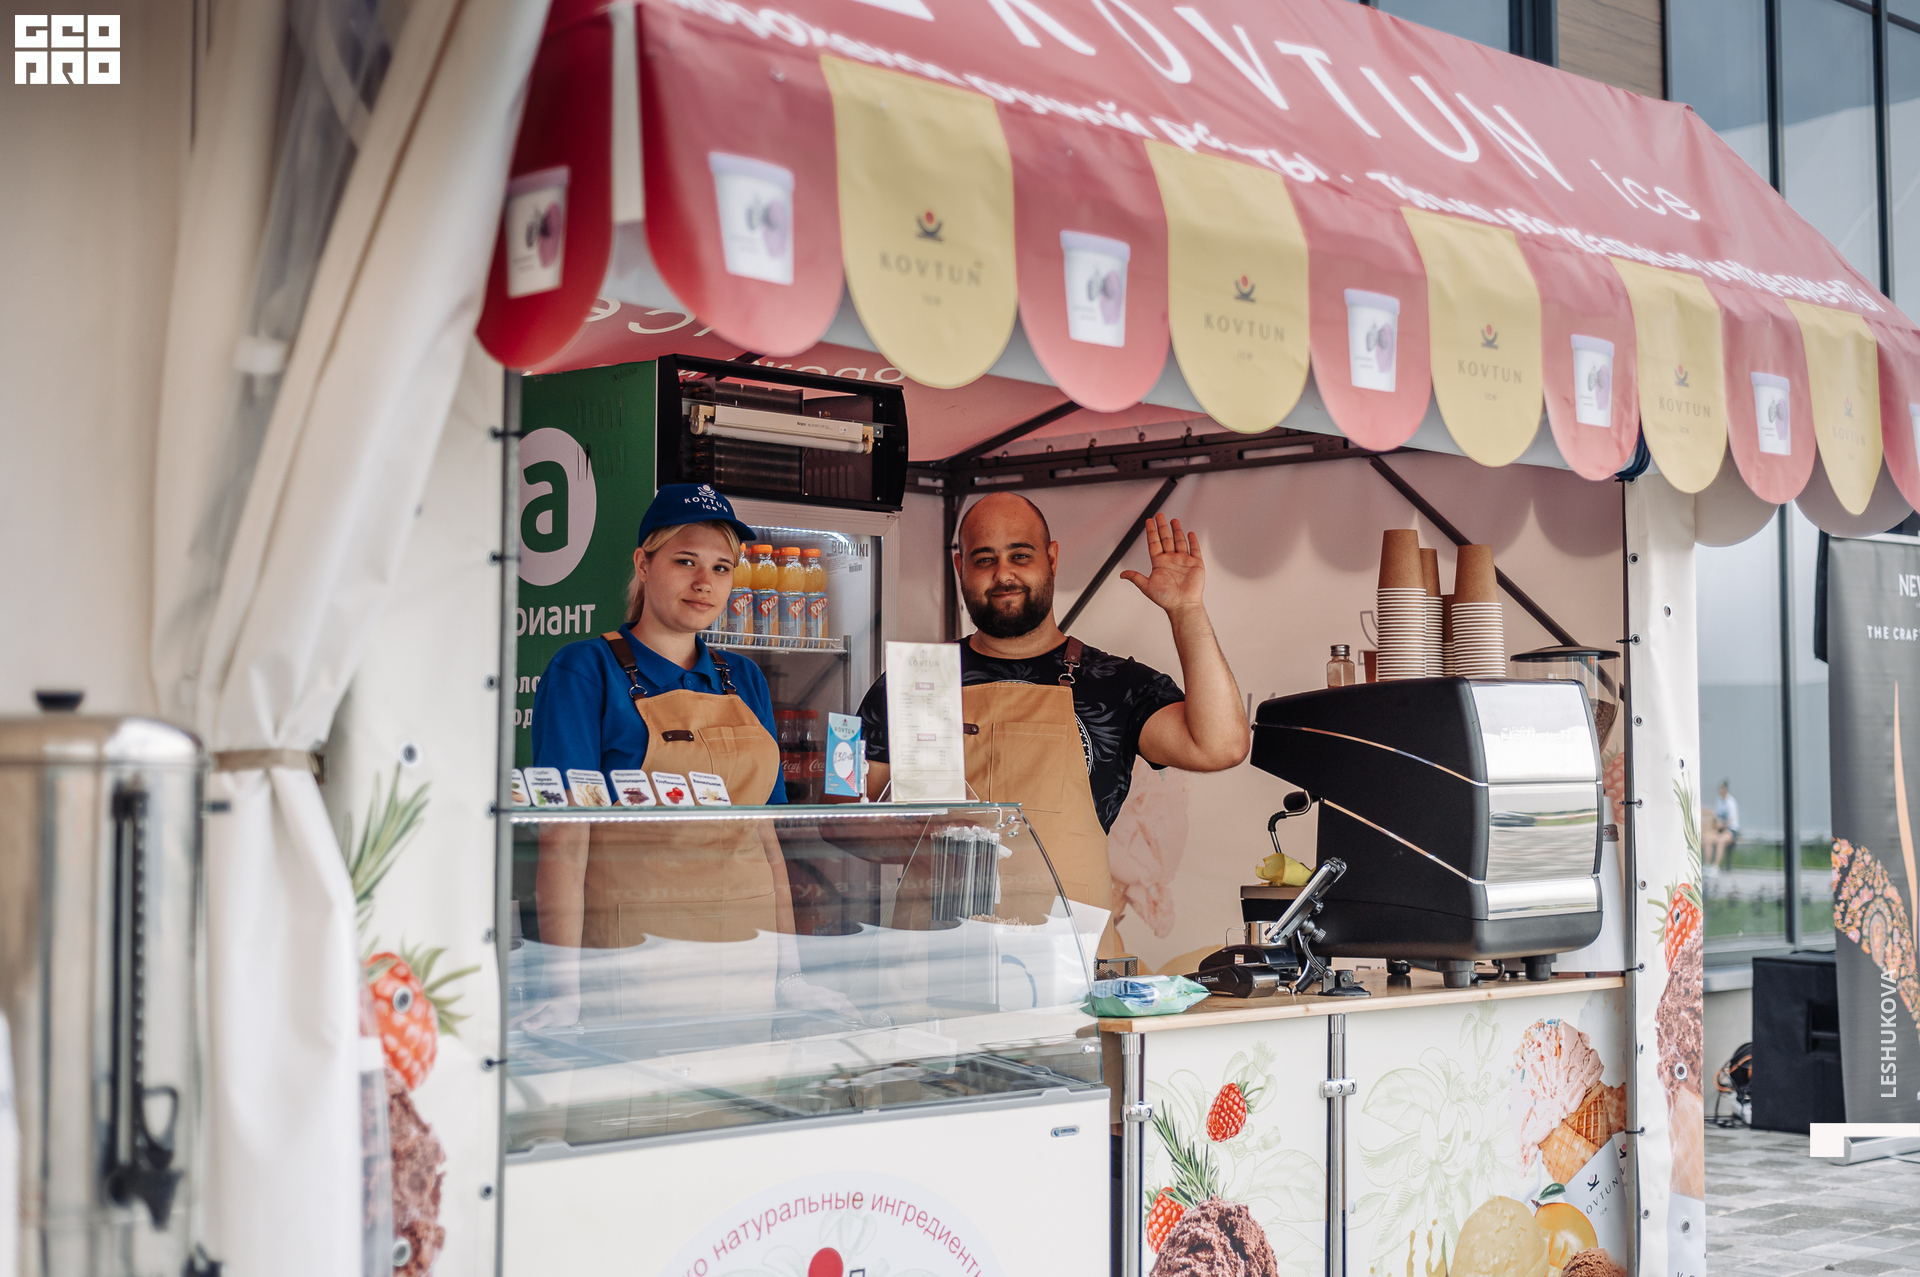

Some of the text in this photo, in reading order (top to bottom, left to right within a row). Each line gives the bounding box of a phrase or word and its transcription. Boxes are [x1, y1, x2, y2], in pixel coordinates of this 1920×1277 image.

[879, 250, 982, 288] KOVTUN
[1204, 312, 1285, 343] KOVTUN
[1457, 359, 1522, 384] KOVTUN
[1658, 396, 1711, 418] KOVTUN
[684, 496, 728, 513] KOVTUN
[1866, 625, 1920, 642] THE CRAF
[712, 1191, 864, 1261] натуральные
